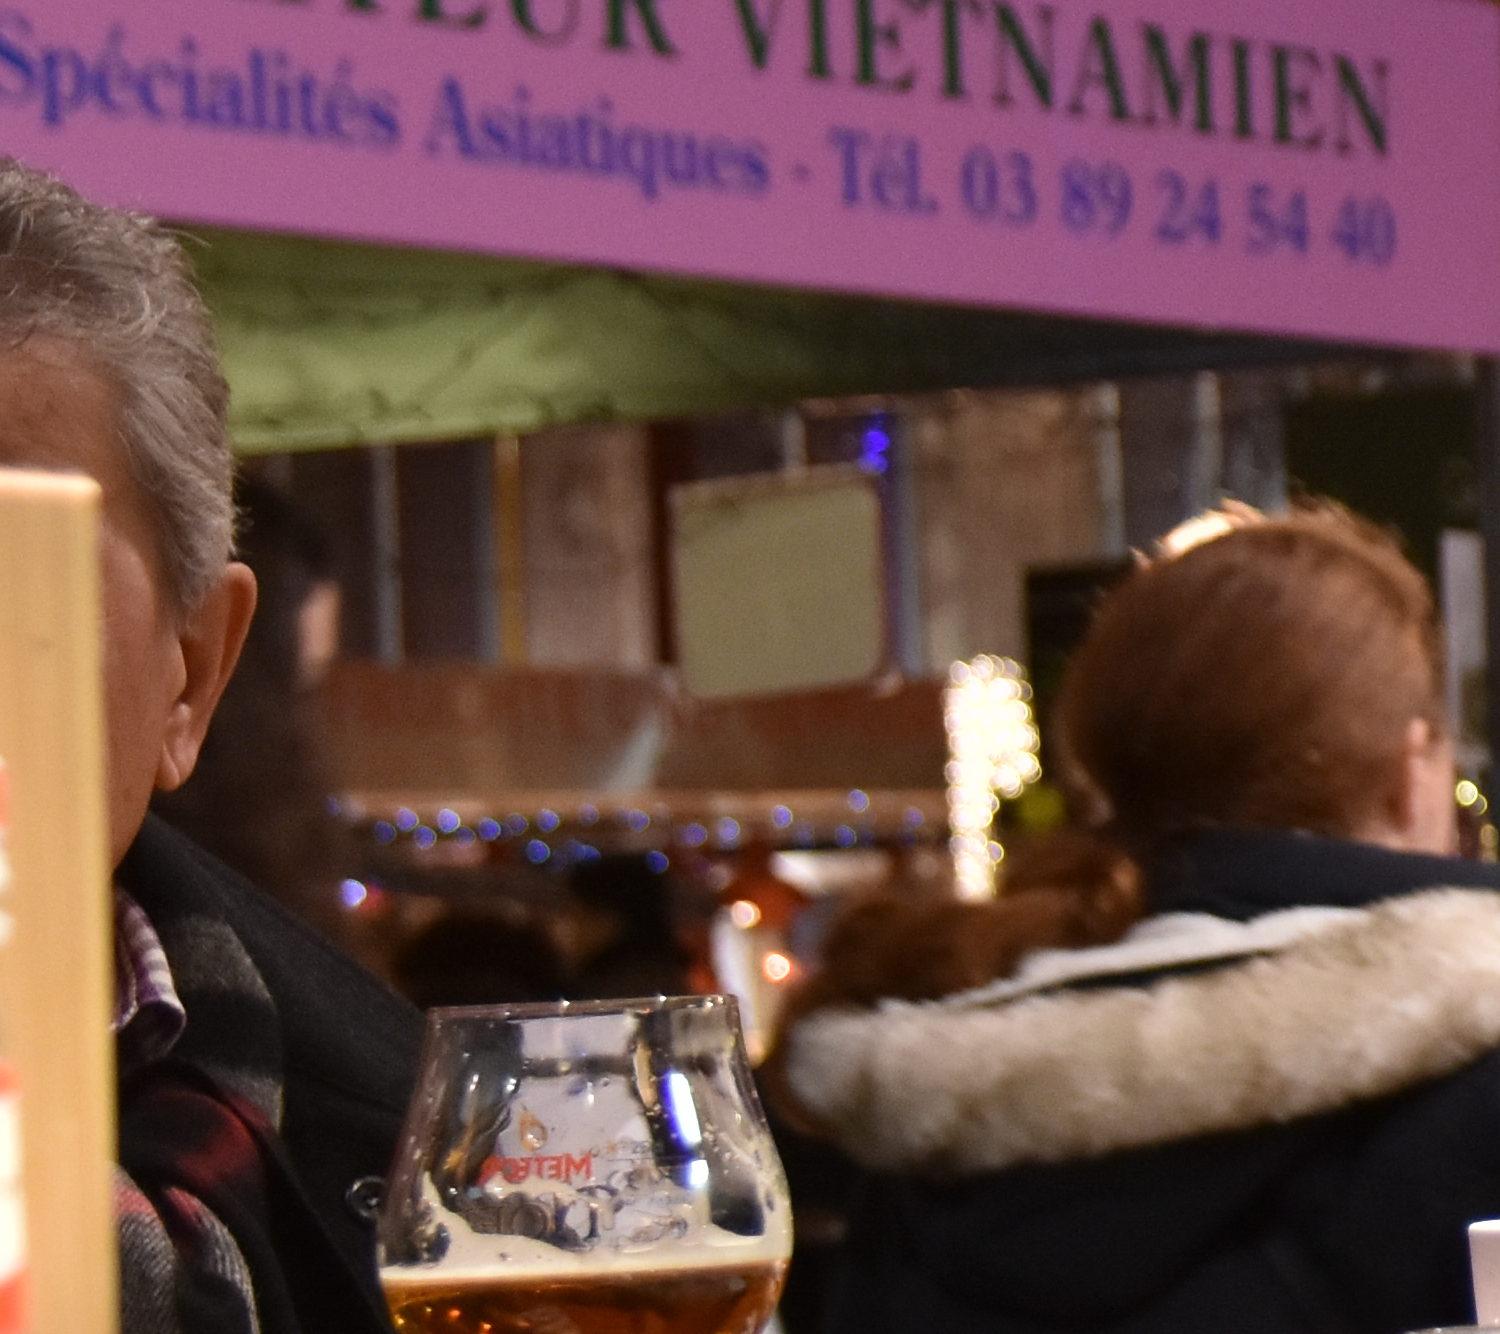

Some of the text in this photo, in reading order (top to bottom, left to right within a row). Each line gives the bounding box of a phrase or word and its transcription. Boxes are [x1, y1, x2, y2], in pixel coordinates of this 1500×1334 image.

[0, 9, 398, 147] Spécialités
[424, 73, 770, 199] Asiatiques
[829, 124, 937, 214] Tél.
[960, 147, 1038, 227] 03
[1060, 160, 1132, 237] 89
[1155, 170, 1222, 245] 24
[1246, 181, 1310, 255] 54
[1332, 196, 1397, 264] 40
